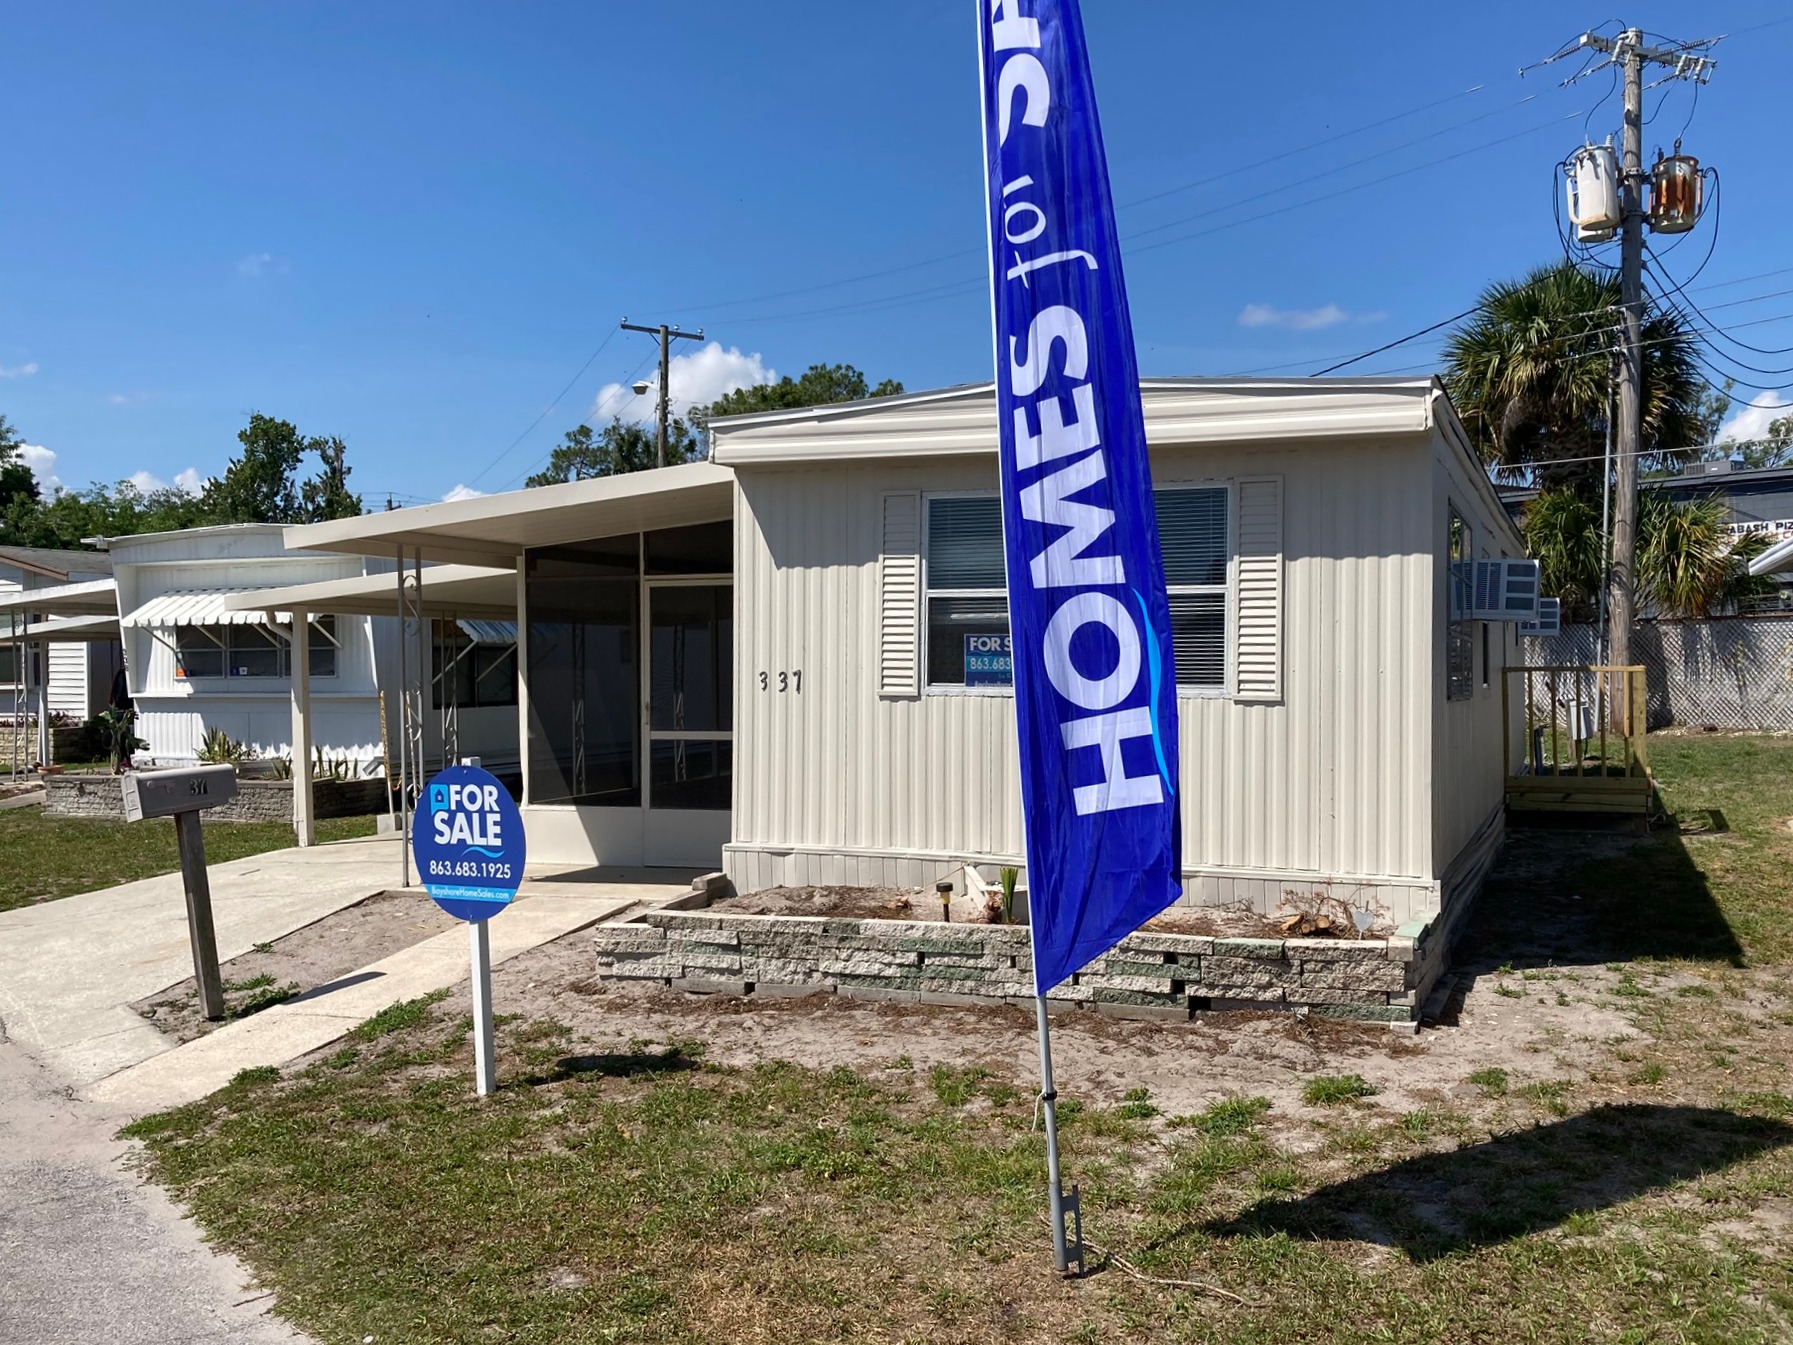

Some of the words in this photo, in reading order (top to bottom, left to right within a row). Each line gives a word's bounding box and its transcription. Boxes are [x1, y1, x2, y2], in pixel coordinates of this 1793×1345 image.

[1728, 522, 1769, 534] ABASH
[1775, 522, 1793, 531] PIZ
[1010, 305, 1164, 816] HOMES
[969, 637, 1001, 651] FOR
[970, 658, 1011, 670] 863.683
[759, 669, 802, 695] 337
[450, 784, 500, 811] FOR
[434, 811, 502, 846] SALE
[430, 860, 511, 879] 863.683.1925
[431, 885, 510, 900] BayshoreHomeSales.com
